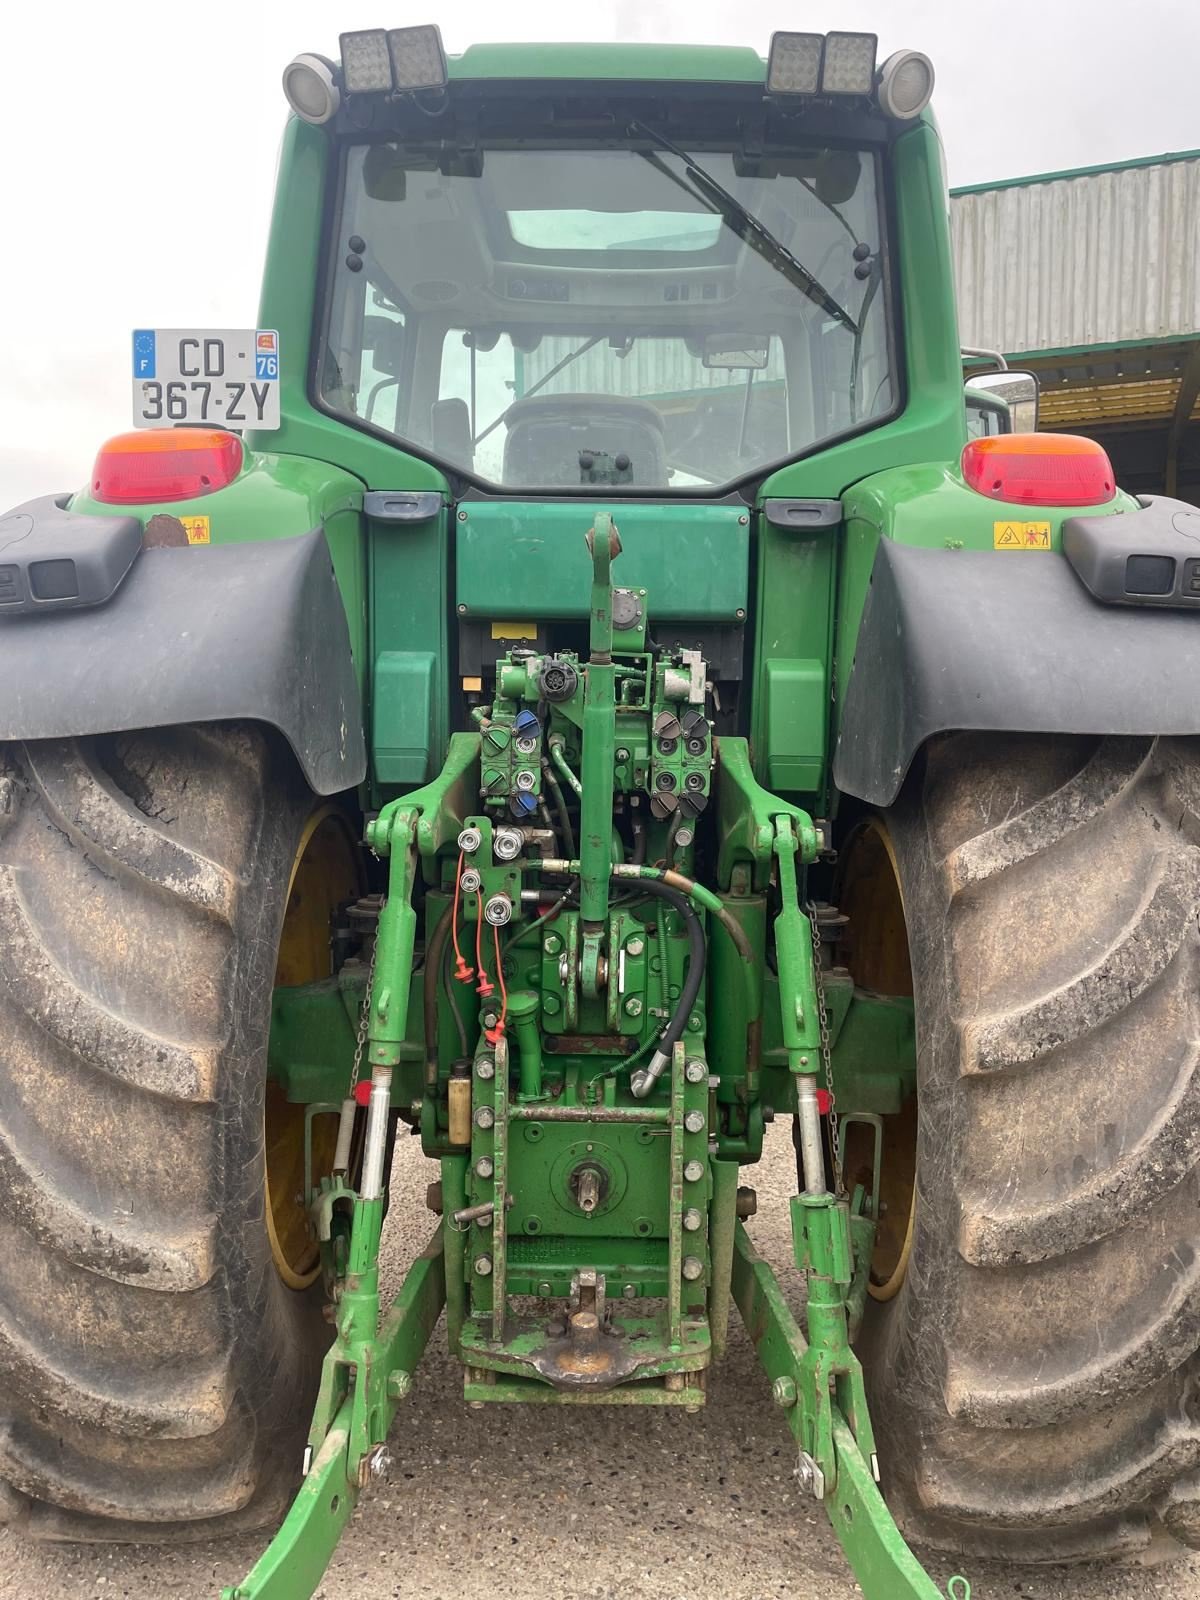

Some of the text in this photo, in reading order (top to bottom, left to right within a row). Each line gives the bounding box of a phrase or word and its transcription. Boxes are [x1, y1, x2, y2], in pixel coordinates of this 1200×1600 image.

[140, 360, 148, 371] F
[257, 357, 277, 376] 76
[142, 381, 271, 421] 367-ZY
